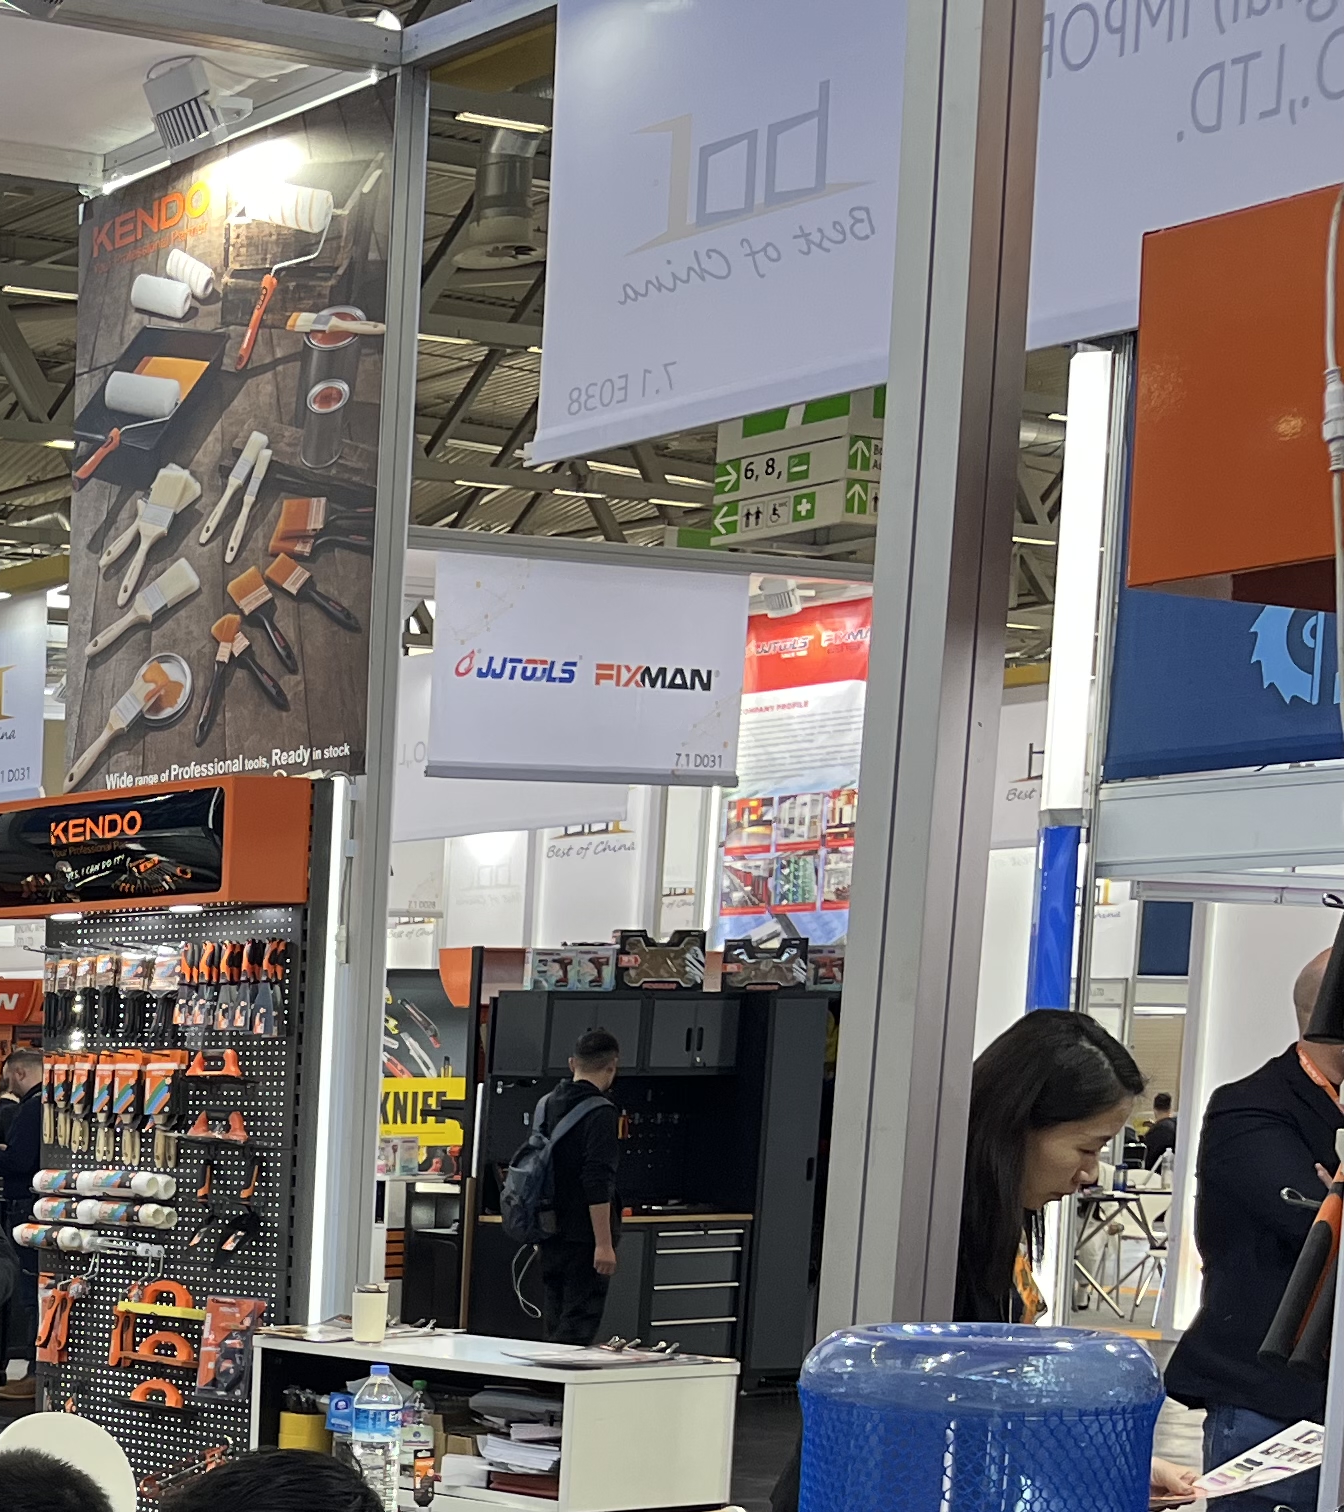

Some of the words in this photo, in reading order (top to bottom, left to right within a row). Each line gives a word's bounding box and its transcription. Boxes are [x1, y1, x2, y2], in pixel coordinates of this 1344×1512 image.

[92, 180, 211, 257] KENDO
[594, 662, 713, 692] FIXMAN
[7, 766, 31, 782] D031
[105, 772, 134, 791] Wide
[135, 774, 159, 787] range
[160, 771, 170, 784] of
[170, 754, 243, 782] Professional
[271, 745, 311, 768] Ready
[312, 747, 322, 761] in
[323, 743, 351, 759] stock
[674, 752, 691, 768] 7.1
[694, 753, 723, 769] D031
[50, 810, 143, 846] KENDO
[545, 844, 572, 860] Best
[576, 842, 591, 859] of
[592, 839, 637, 856] China
[380, 1091, 448, 1125] KNIFE
